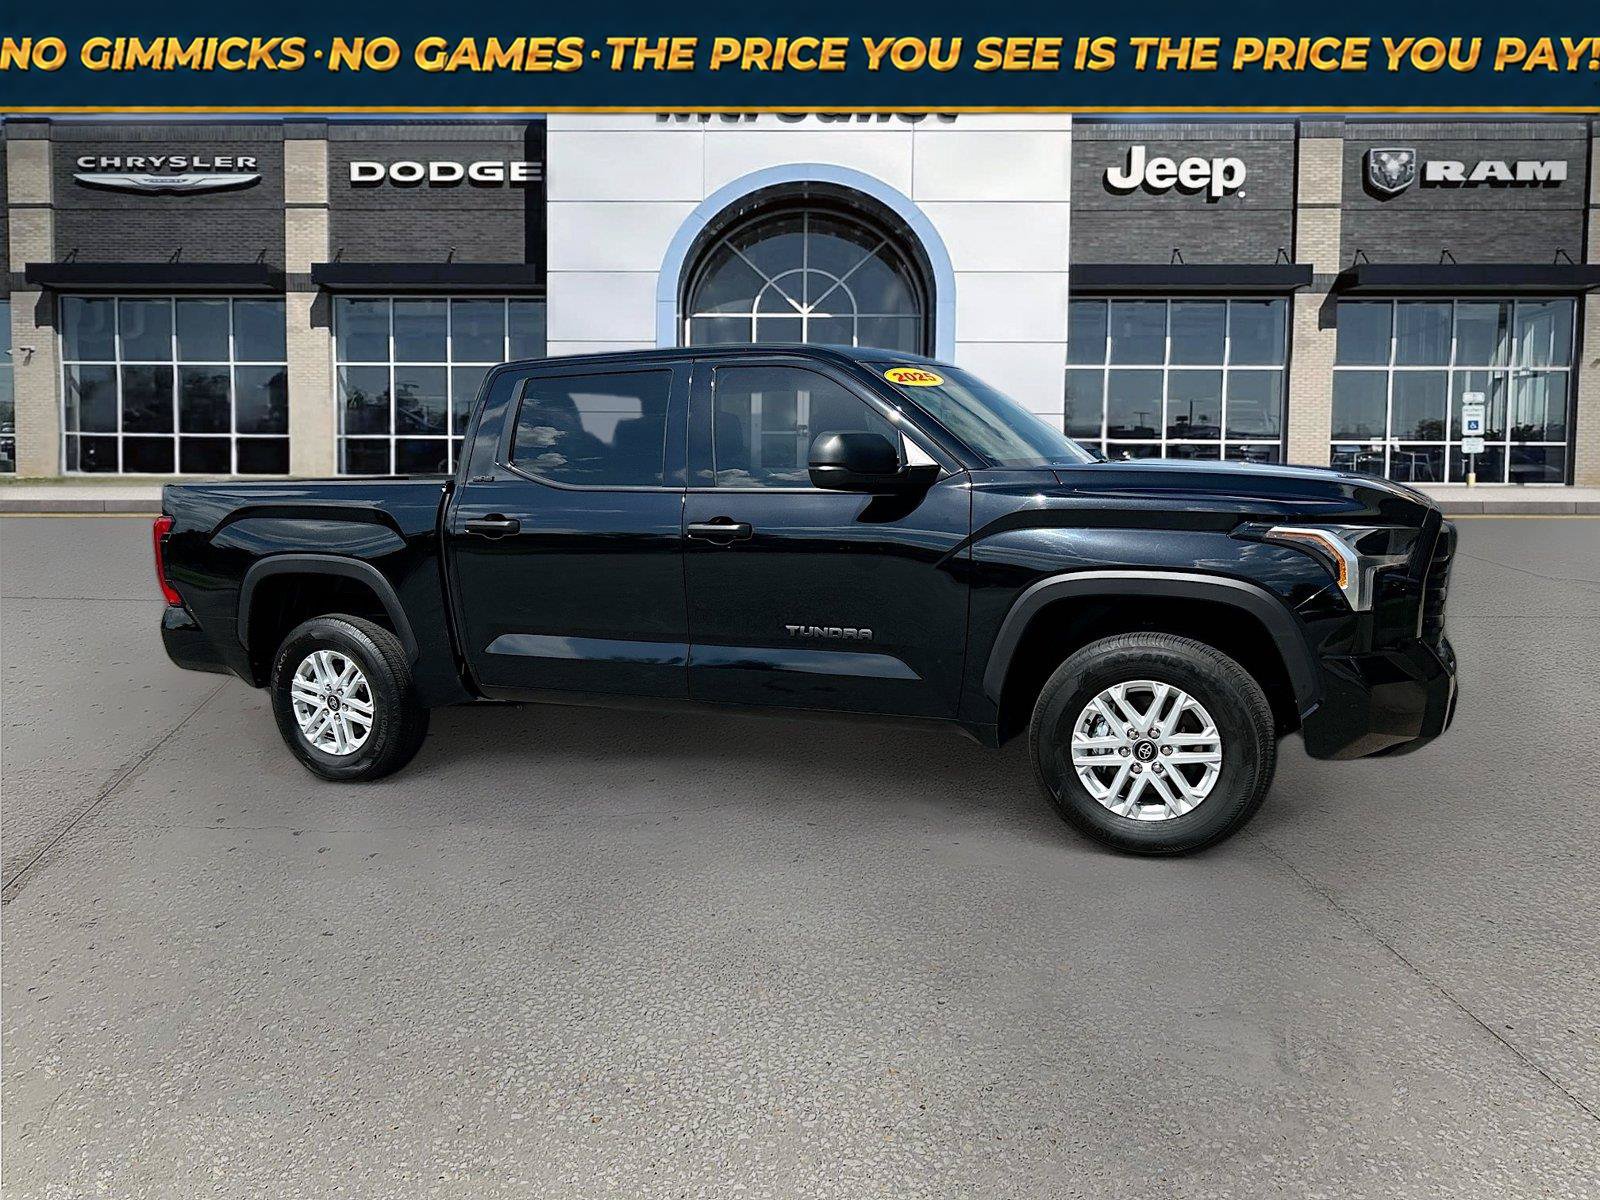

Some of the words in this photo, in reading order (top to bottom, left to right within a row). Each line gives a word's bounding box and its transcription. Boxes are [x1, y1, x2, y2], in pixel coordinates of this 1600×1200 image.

[76, 156, 257, 168] CHRYSLER
[349, 161, 543, 182] DODGE
[1106, 145, 1247, 197] Jeep
[1425, 160, 1568, 181] RAM
[892, 371, 938, 383] 2025
[785, 624, 874, 641] TUNDRA
